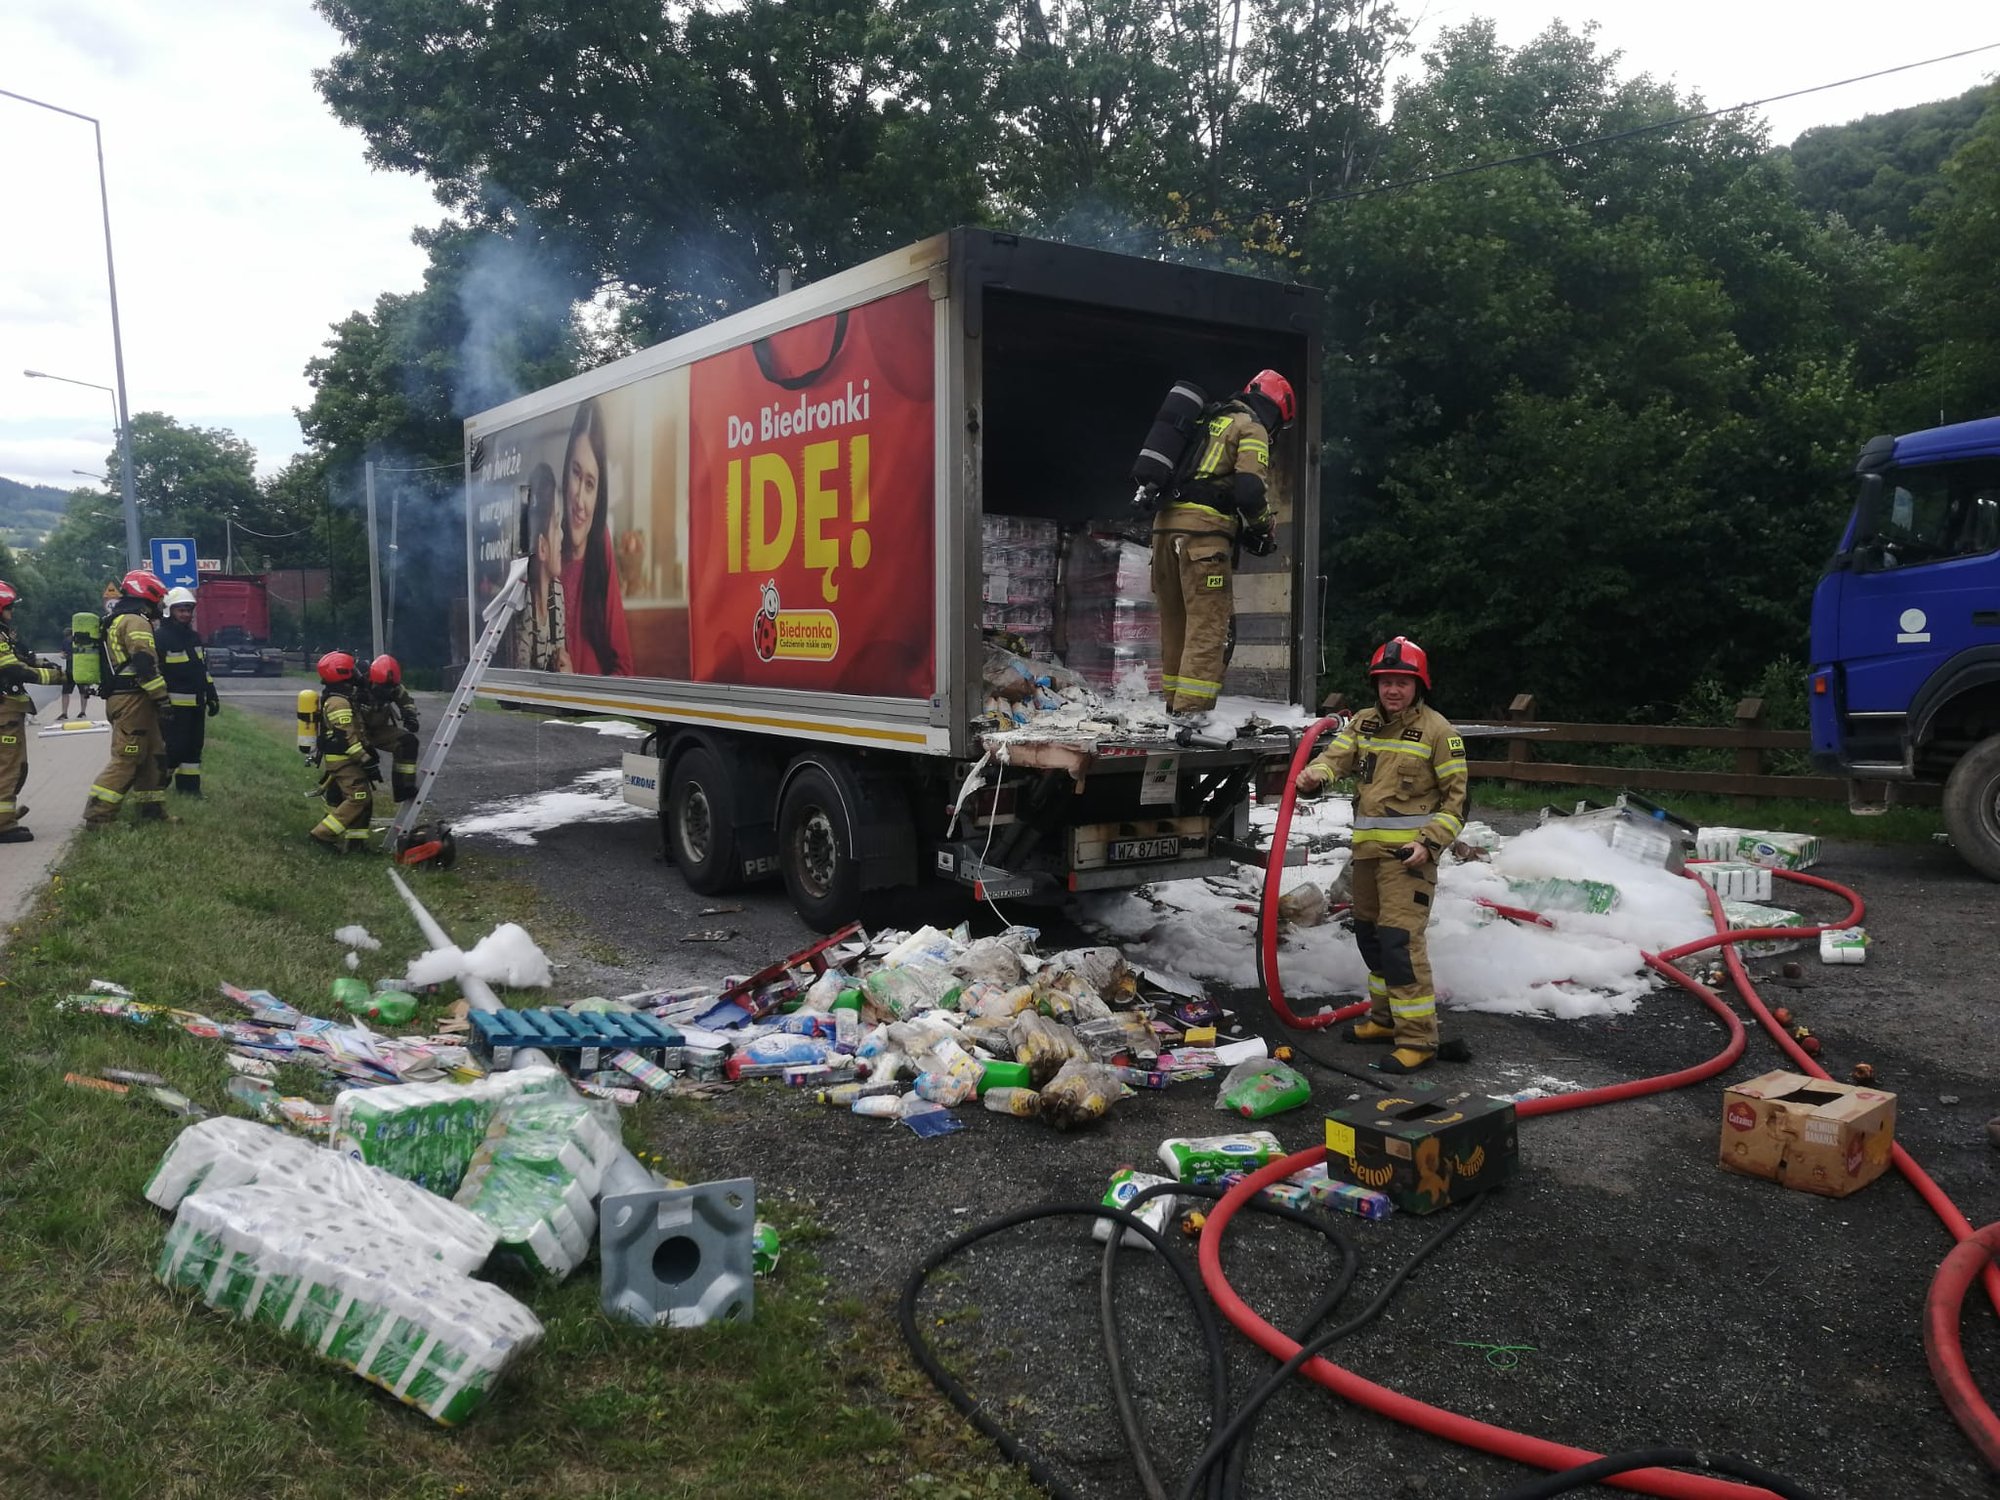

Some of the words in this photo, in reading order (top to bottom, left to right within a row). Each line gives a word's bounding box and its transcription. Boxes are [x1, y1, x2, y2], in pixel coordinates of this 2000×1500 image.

[728, 415, 754, 449] Do
[760, 378, 870, 442] Biedronki
[726, 434, 872, 603] IDĘ!
[161, 543, 188, 574] P
[779, 621, 832, 639] Biedronka
[630, 775, 656, 790] KRONE
[1118, 843, 1135, 859] WZ
[1138, 839, 1177, 858] 871EN
[744, 855, 781, 876] PEM
